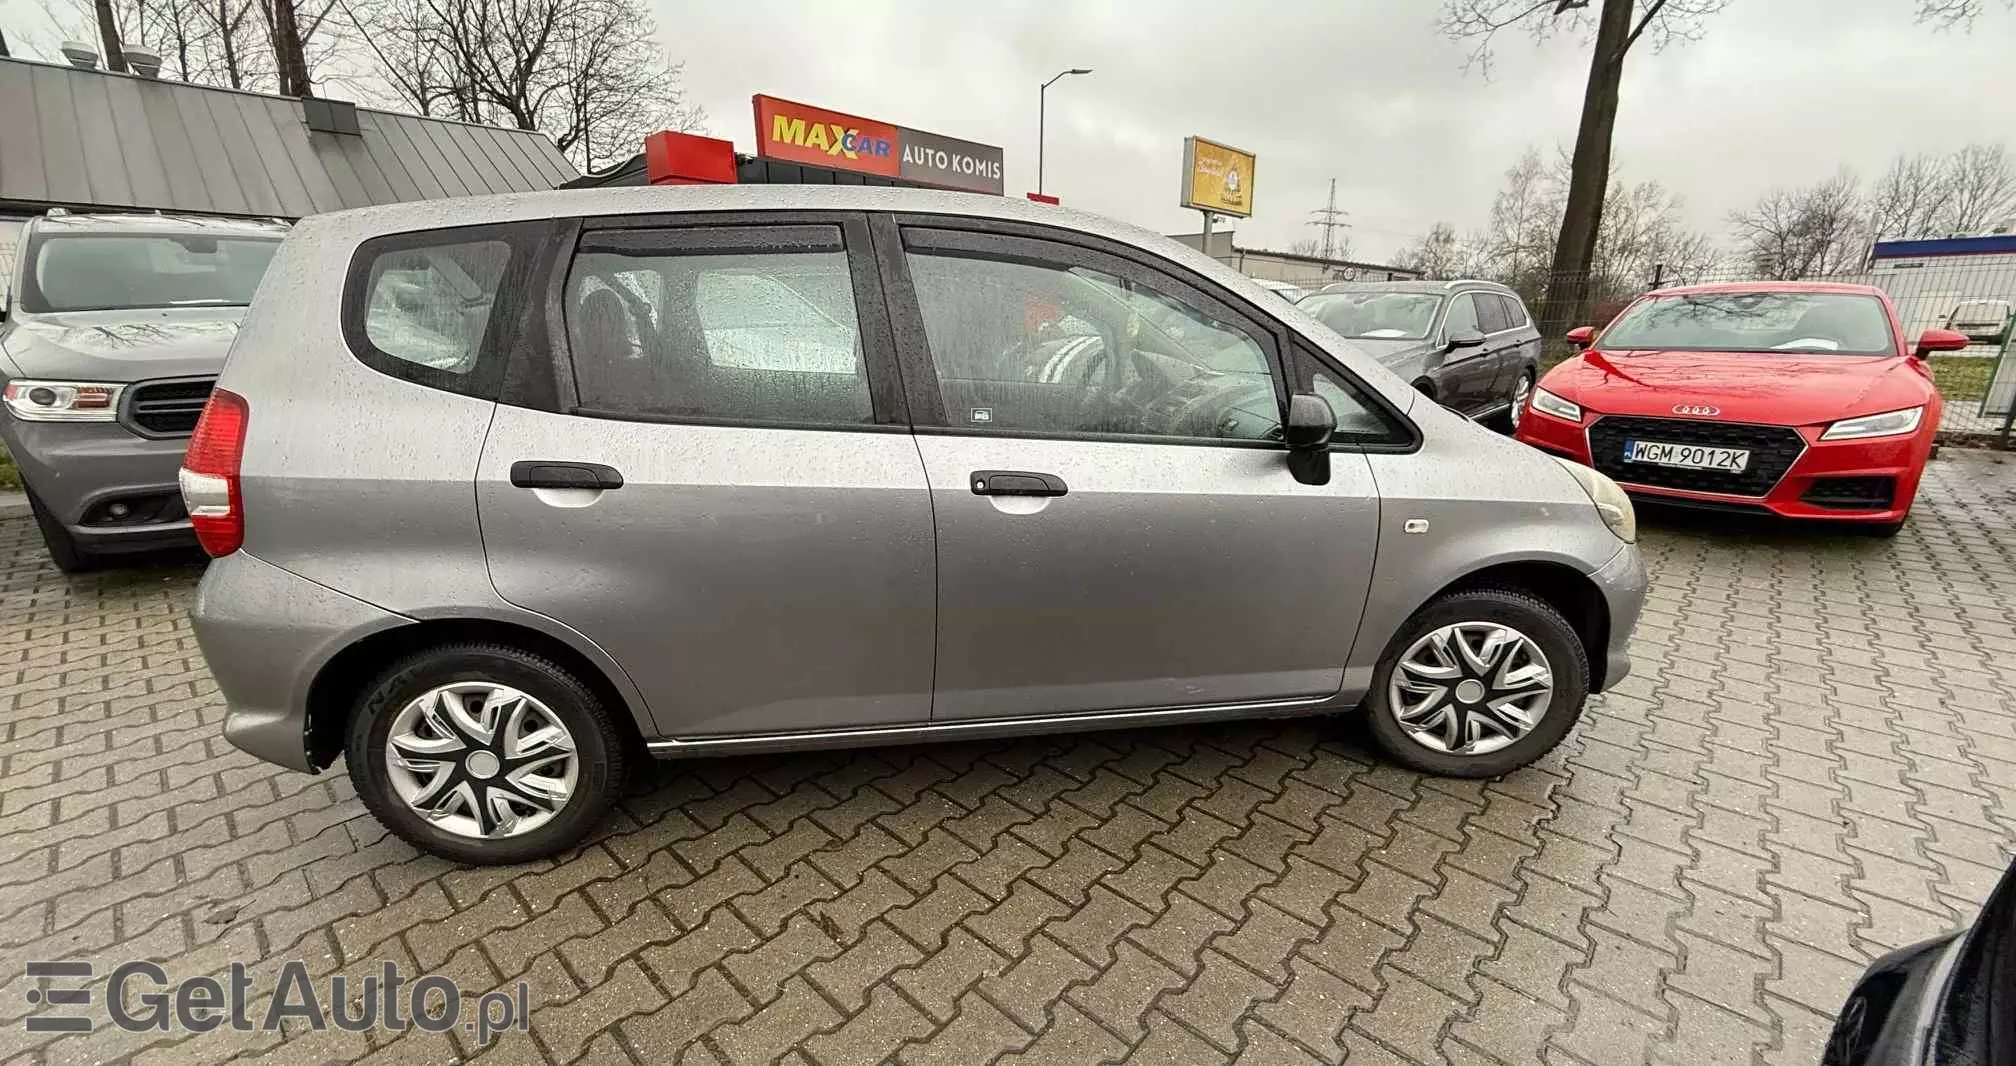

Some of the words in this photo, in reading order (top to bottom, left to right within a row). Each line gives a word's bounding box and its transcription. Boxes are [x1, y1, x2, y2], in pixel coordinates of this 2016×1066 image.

[903, 144, 948, 169] AUTO
[952, 154, 1001, 180] KOMIS
[1634, 443, 1674, 462] WGM
[1680, 447, 1746, 469] 9012K
